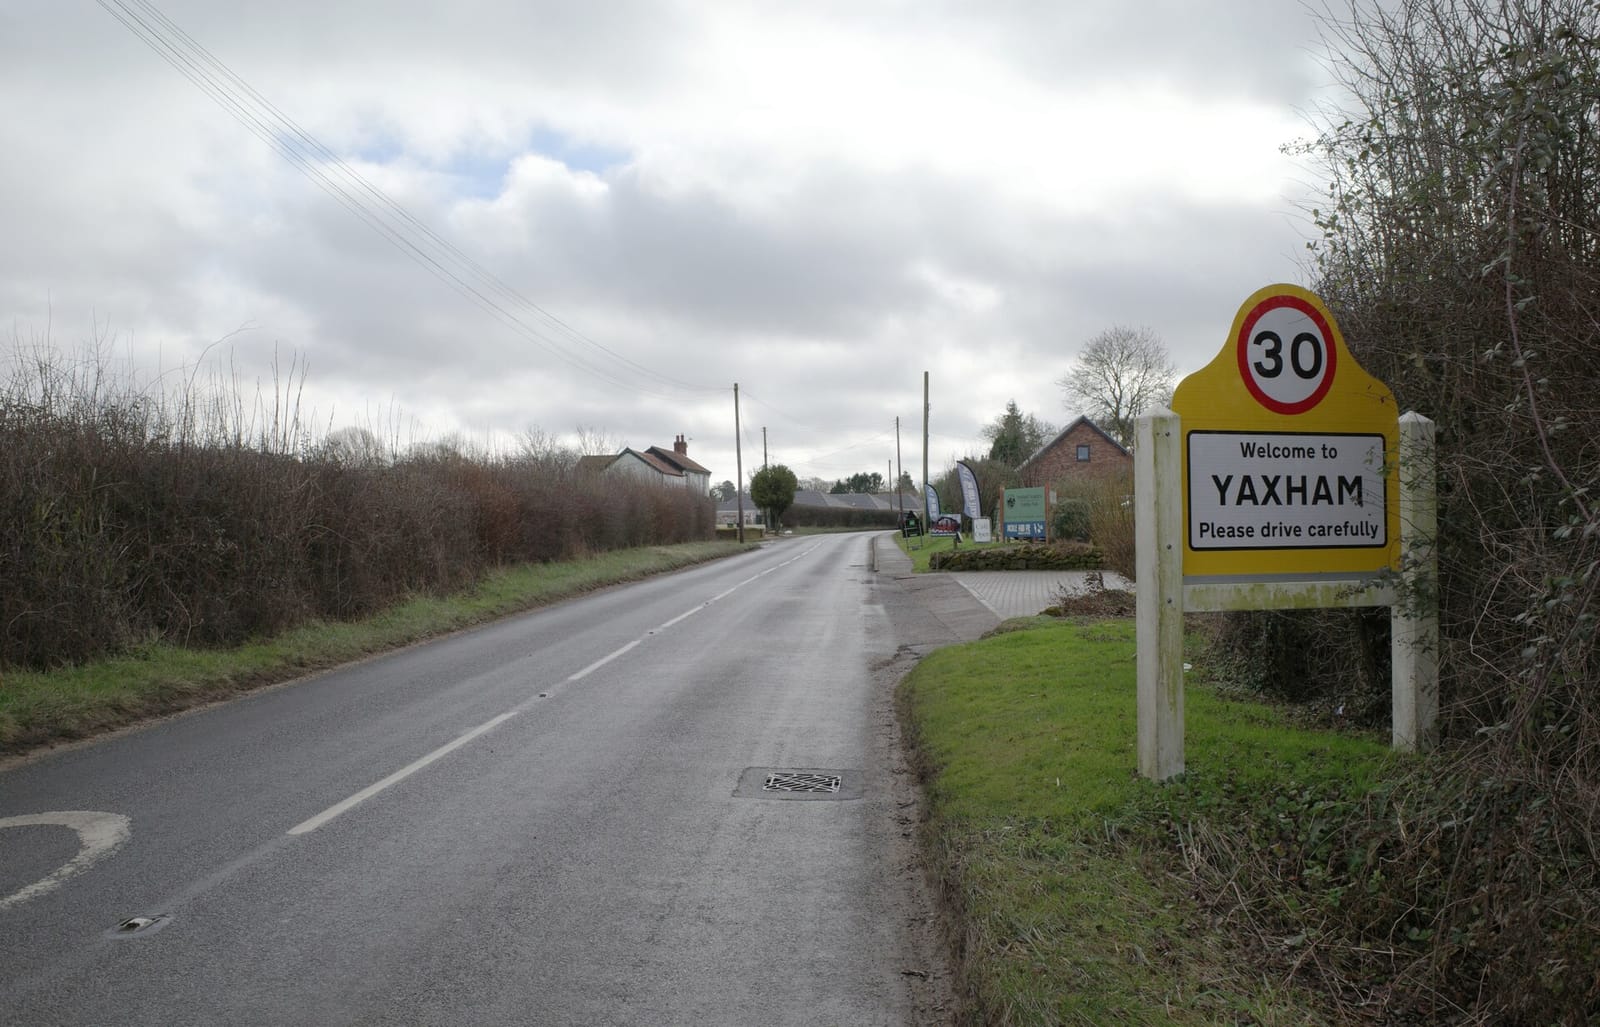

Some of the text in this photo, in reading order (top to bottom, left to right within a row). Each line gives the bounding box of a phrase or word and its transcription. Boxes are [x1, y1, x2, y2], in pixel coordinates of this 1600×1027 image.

[1252, 330, 1323, 379] 30
[1240, 441, 1338, 459] Welcome to
[1211, 474, 1364, 506] YAXHAM
[1199, 521, 1379, 539] Please drive carefully
